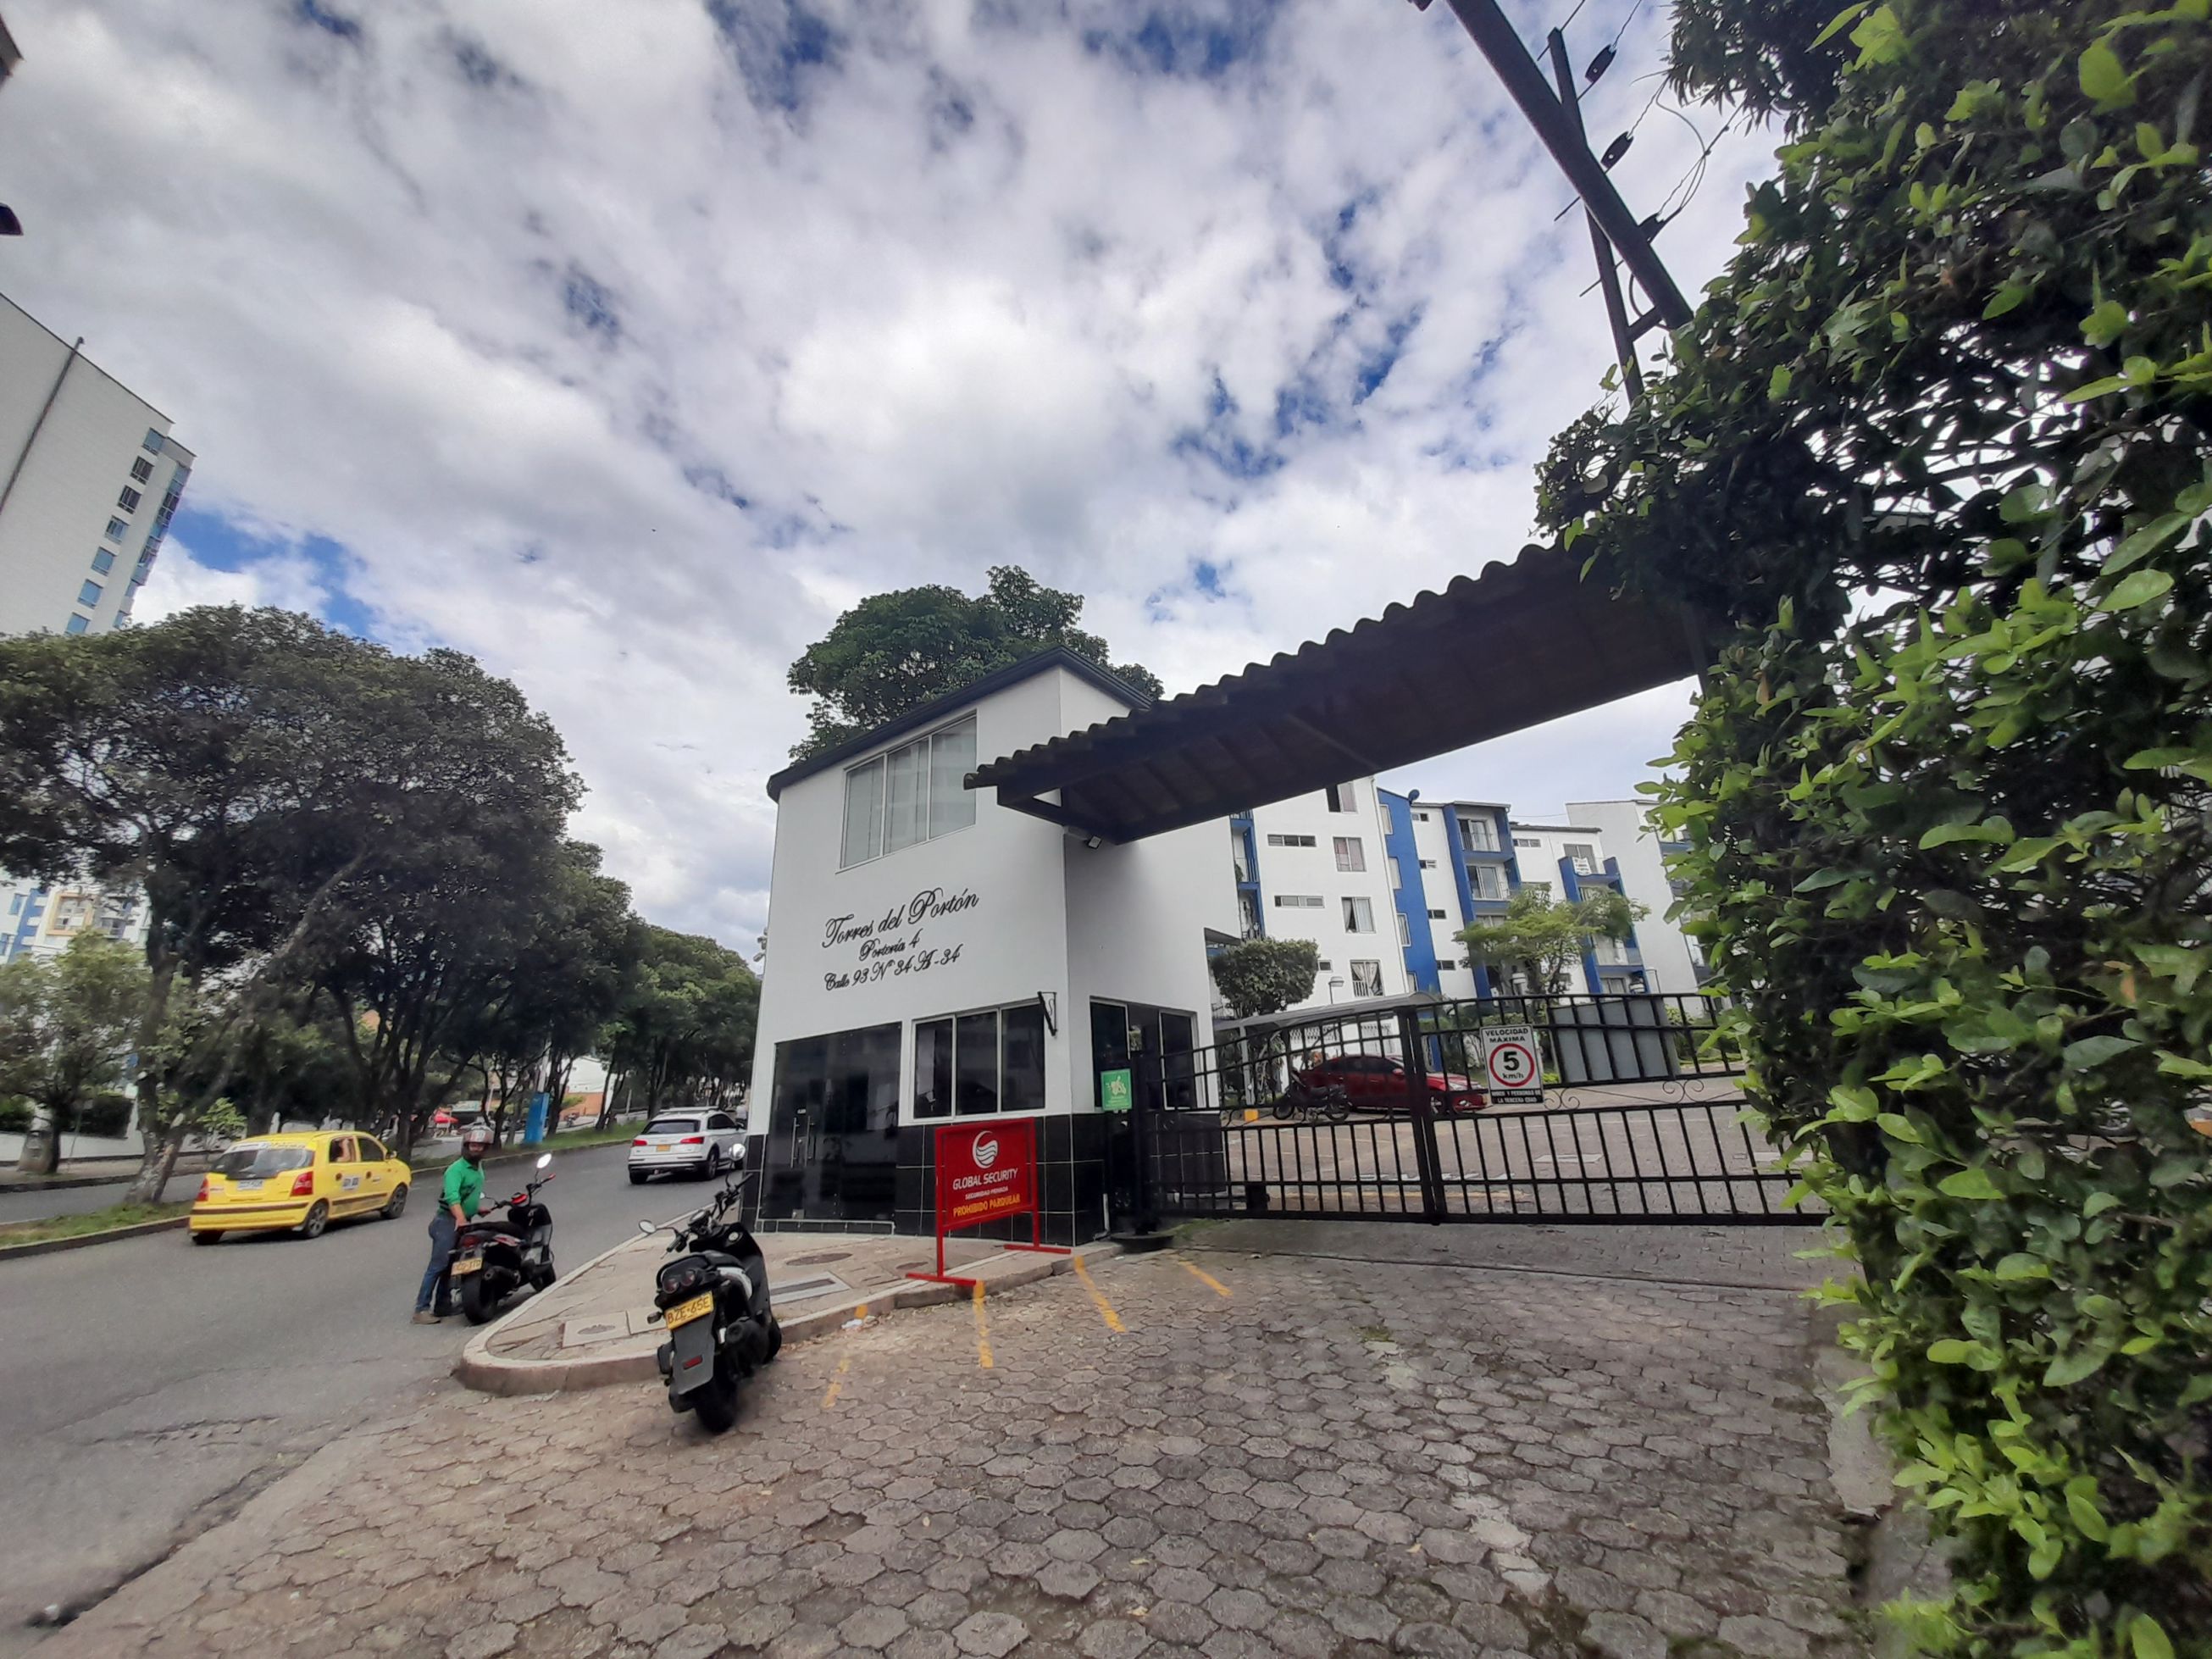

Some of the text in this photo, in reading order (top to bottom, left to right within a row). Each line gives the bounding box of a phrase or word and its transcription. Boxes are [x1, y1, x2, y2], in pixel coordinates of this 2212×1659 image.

[822, 887, 979, 948] Torres del Portón
[858, 928, 923, 961] Portería 4
[824, 973, 850, 991] Calle
[853, 968, 869, 986] 93
[1485, 1028, 1528, 1036] VELOCIDAD
[1503, 1051, 1520, 1071] 5
[952, 1168, 1018, 1190] GLOBAL SECURITY
[952, 1194, 1021, 1217] PROHIBIDO PARQUEAR
